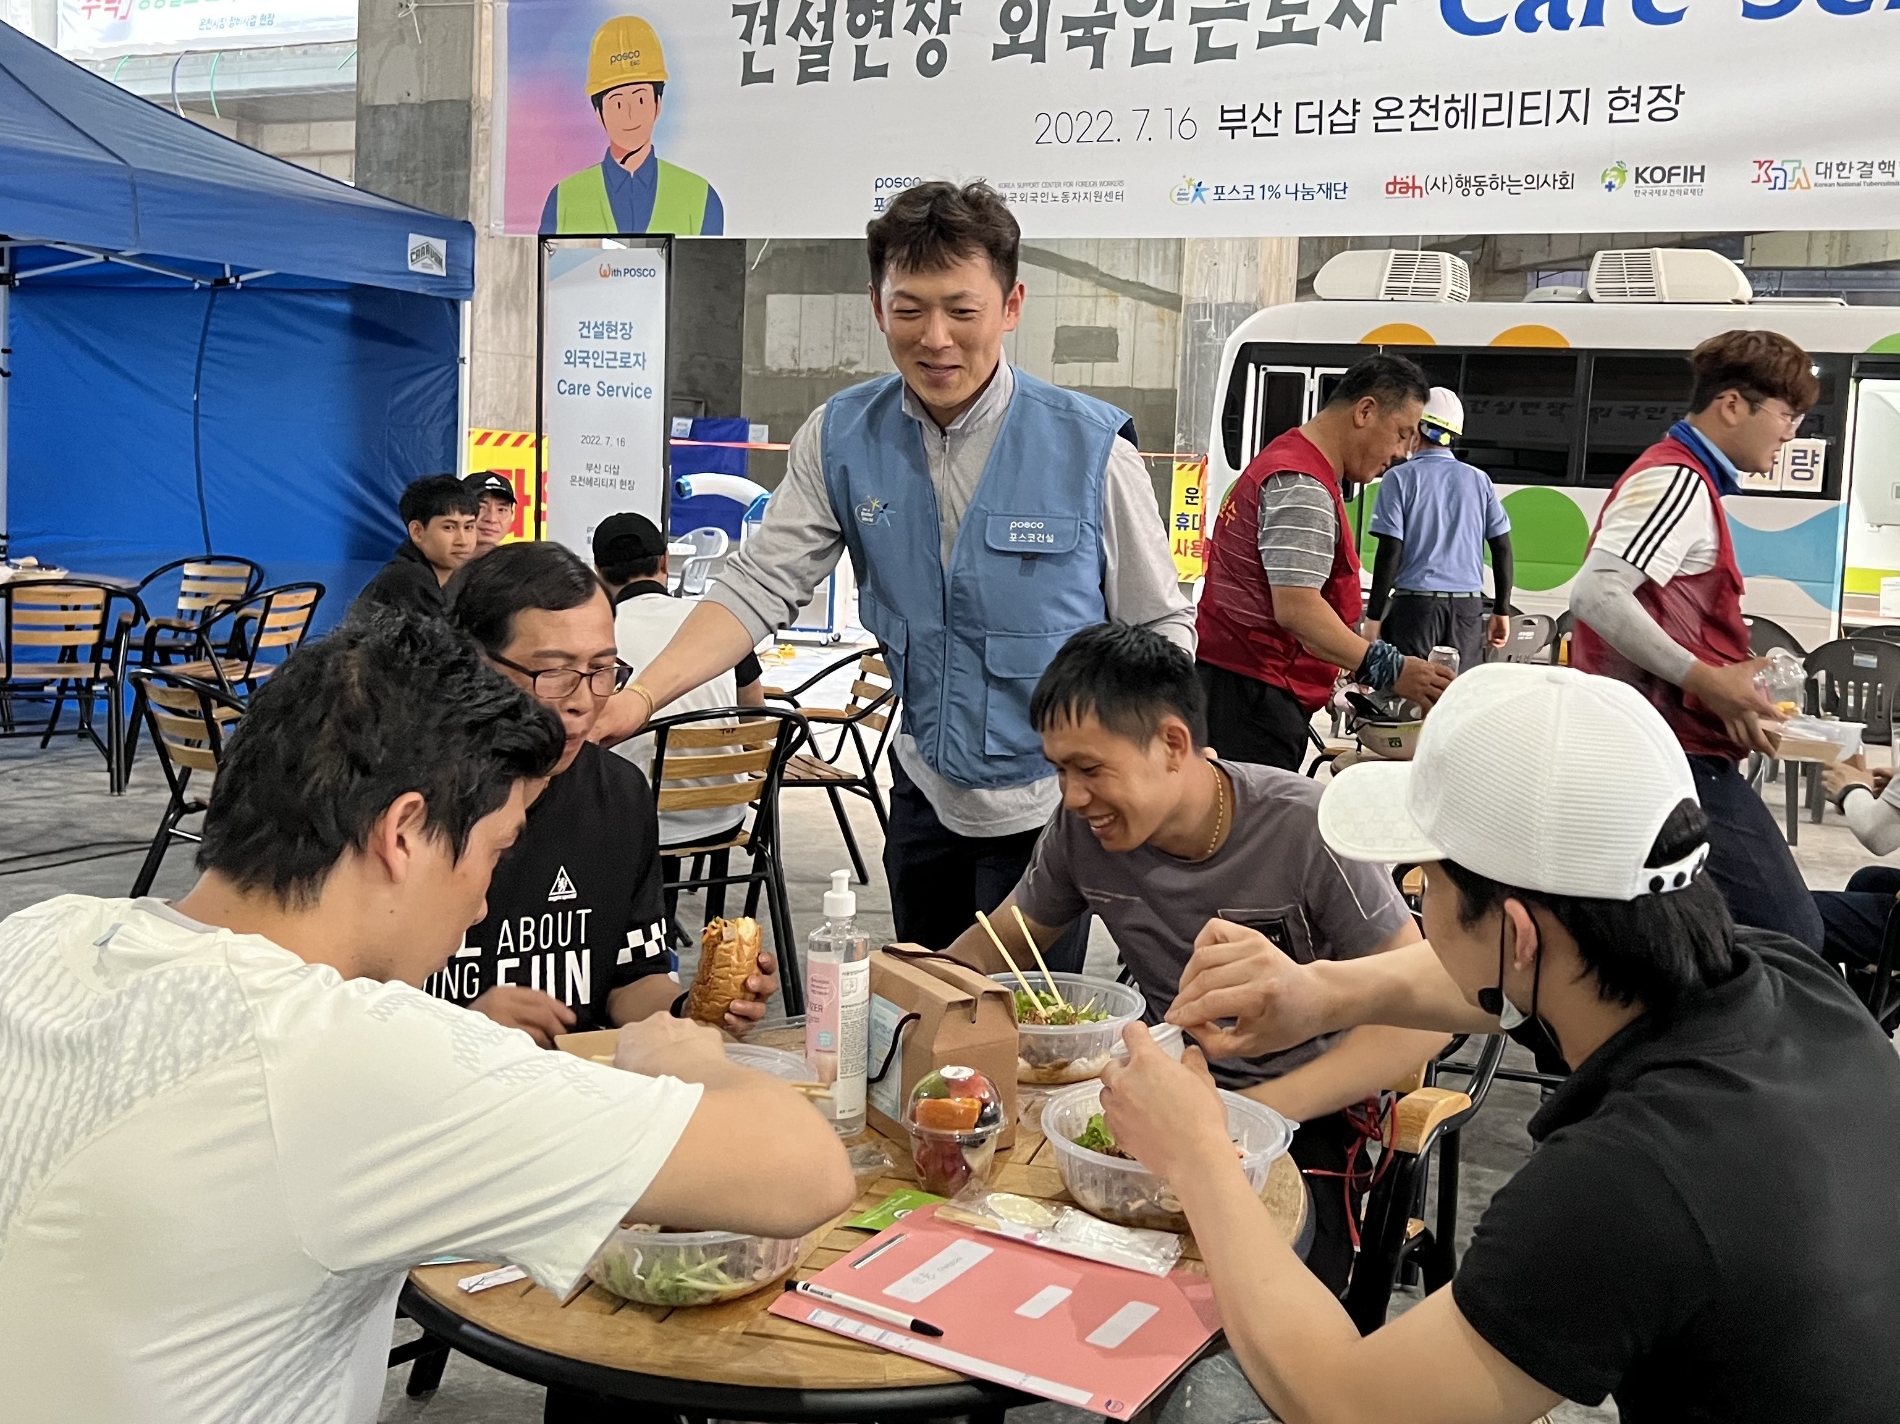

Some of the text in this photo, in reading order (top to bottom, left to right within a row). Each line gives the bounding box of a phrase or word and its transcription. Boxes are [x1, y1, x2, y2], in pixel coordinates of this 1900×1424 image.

[731, 0, 962, 87] 건설현장
[609, 50, 640, 65] posco
[1034, 83, 1686, 145] 2022. 7. 16 부산 더샵 온천헤리티지 현장
[1634, 164, 1706, 184] KOFIH
[1815, 159, 1900, 180] 대한결핵
[1017, 181, 1040, 189] SUPPORT
[1041, 181, 1062, 189] CENTER
[1075, 180, 1098, 188] FOREIGN
[1099, 179, 1125, 187] WORKERS
[1212, 181, 1349, 201] 포스코 1% 나눔재단
[1424, 170, 1576, 198] (사)행동하는의사회
[623, 268, 656, 278] POSCO
[578, 321, 634, 341] 건설현장
[564, 349, 647, 371] 외국인근로자
[557, 379, 653, 399] Care Service
[616, 437, 626, 447] 16
[586, 463, 602, 475] 부산
[619, 479, 636, 491] 현장
[1010, 520, 1044, 531] posco
[1009, 532, 1055, 543] 포스코건설
[497, 908, 593, 956] ABOUT
[423, 961, 480, 999] ING
